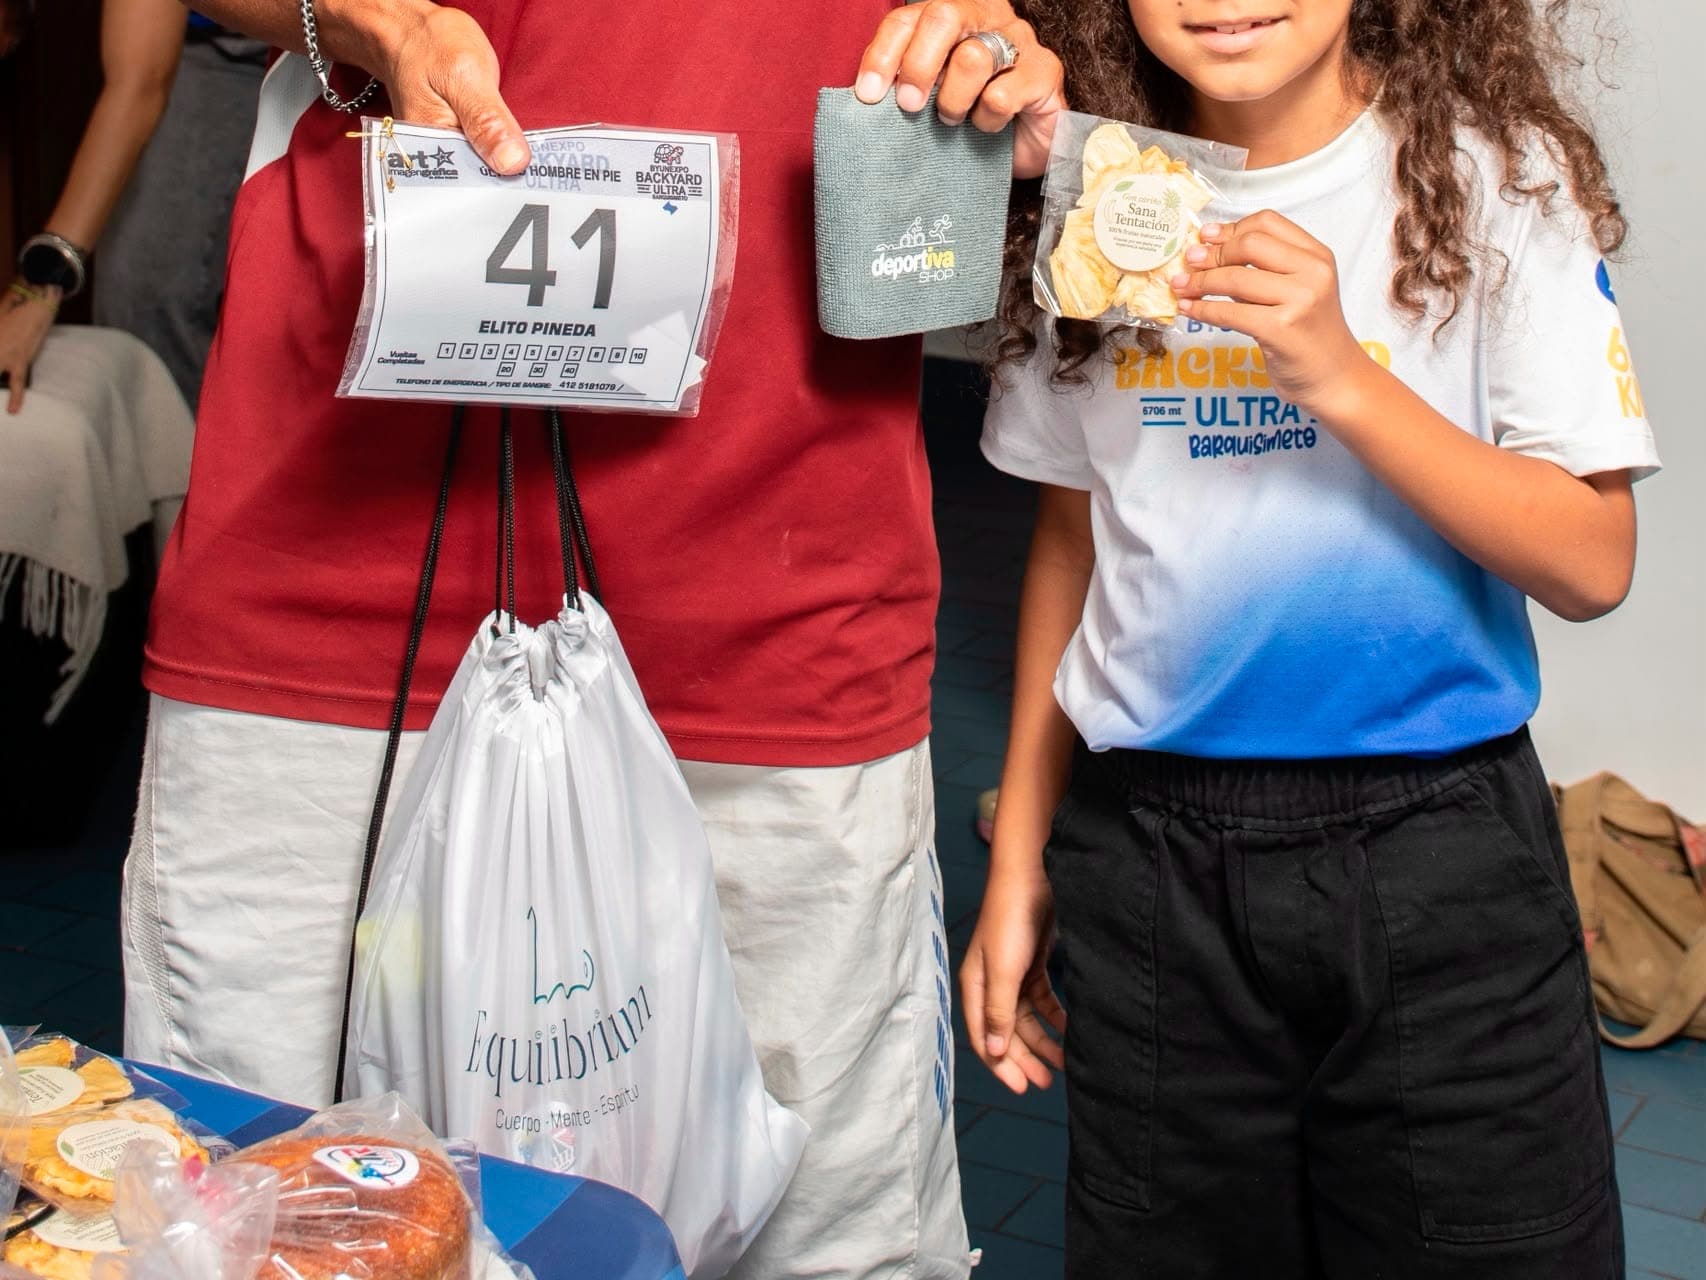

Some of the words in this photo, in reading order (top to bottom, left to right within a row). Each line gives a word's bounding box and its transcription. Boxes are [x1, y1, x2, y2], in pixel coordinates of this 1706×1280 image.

[529, 165, 582, 180] HOMBRE
[584, 168, 600, 181] EN
[602, 169, 622, 183] PIE
[636, 171, 703, 186] BACKYARD
[653, 184, 686, 196] ULTRA
[1128, 202, 1157, 218] Sana
[1115, 212, 1170, 232] Tentación
[485, 203, 617, 310] 41
[871, 246, 955, 280] deportiva
[920, 269, 954, 282] SHOP
[478, 320, 528, 335] ELITO
[531, 322, 596, 337] PINEDA
[560, 381, 576, 389] 412
[1142, 406, 1166, 416] 6706
[1168, 407, 1182, 416] mt
[1195, 396, 1301, 427] ULTRA
[464, 985, 652, 1097] Equilibrium
[495, 1109, 541, 1135] Cuerpo
[550, 1109, 592, 1129] Mente
